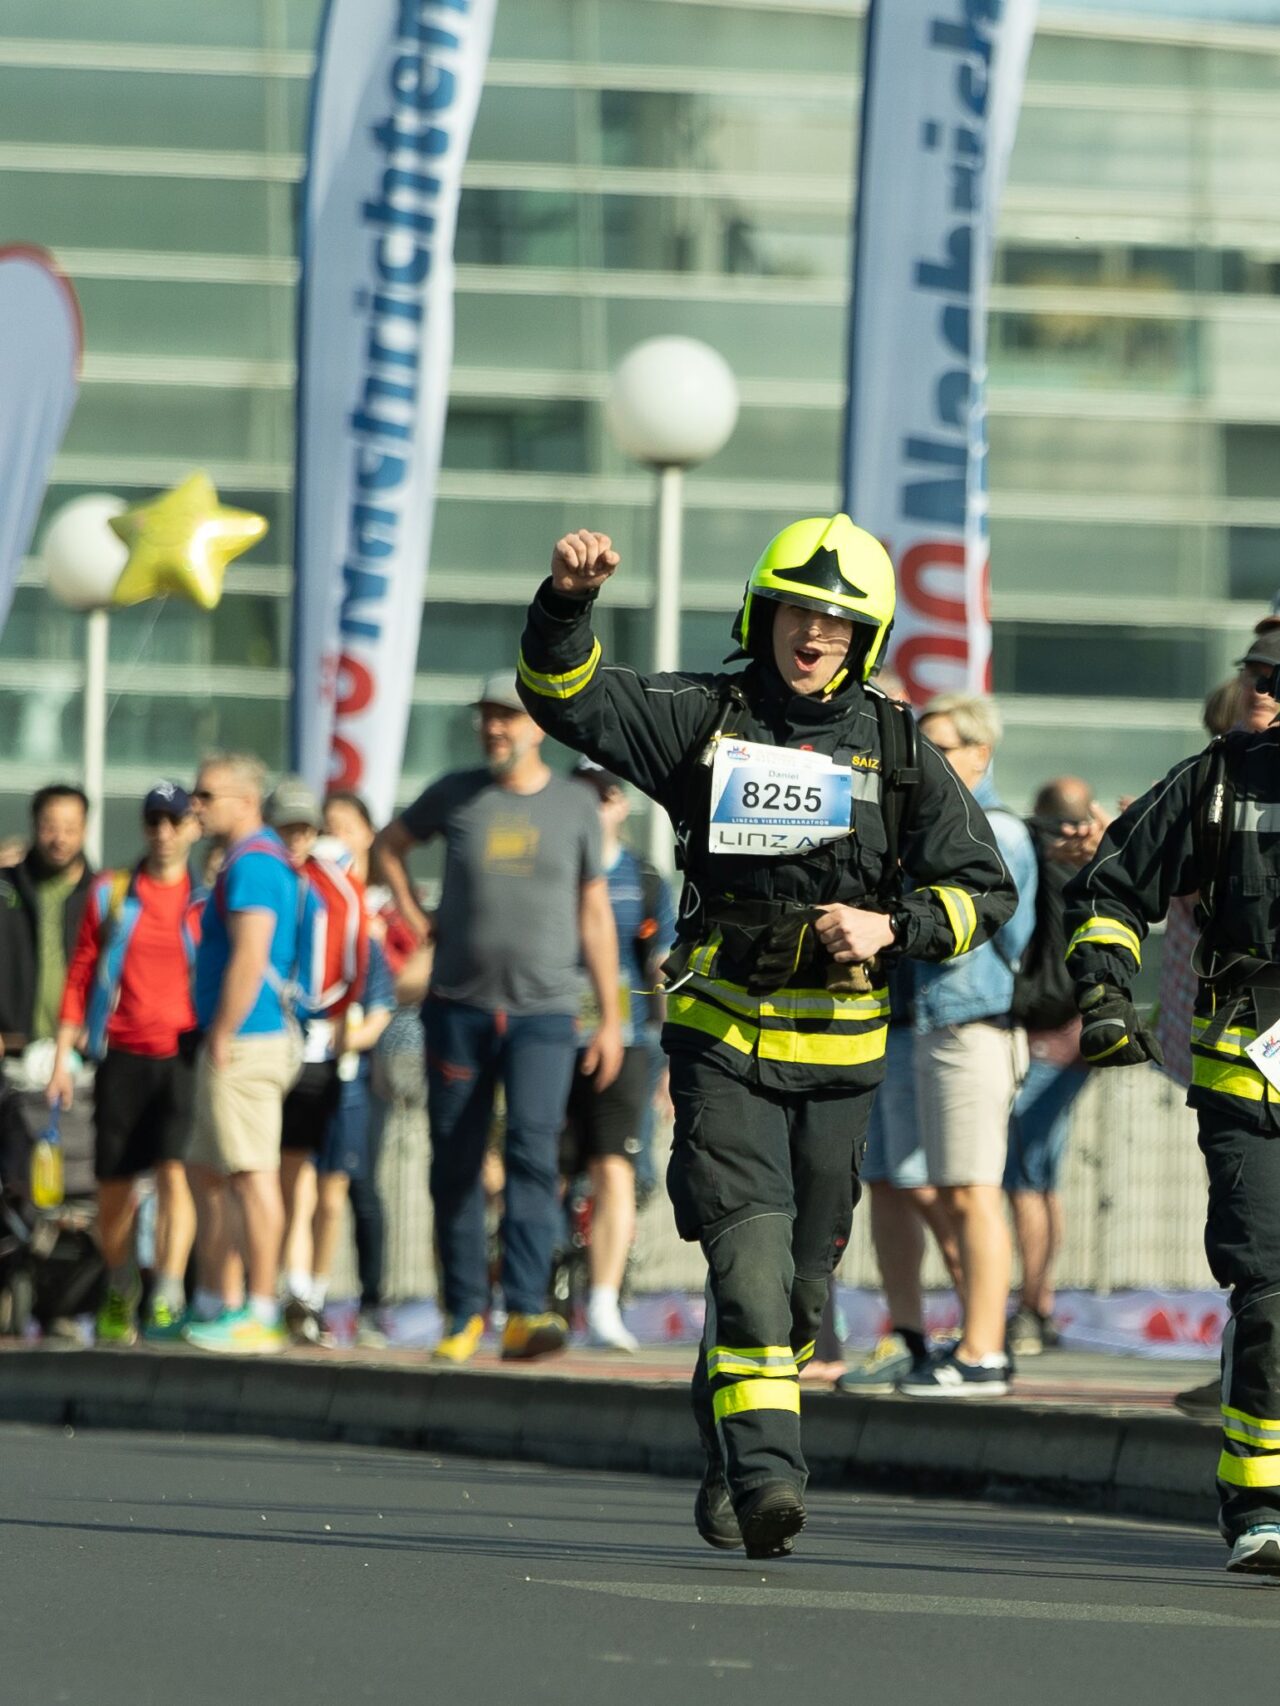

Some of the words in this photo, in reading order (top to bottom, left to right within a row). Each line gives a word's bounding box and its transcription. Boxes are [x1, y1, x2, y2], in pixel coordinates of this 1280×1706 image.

[768, 769, 799, 780] Daniel
[741, 781, 822, 813] 8255
[761, 818, 830, 826] VIERTELMARATHON
[719, 830, 788, 849] LINZ
